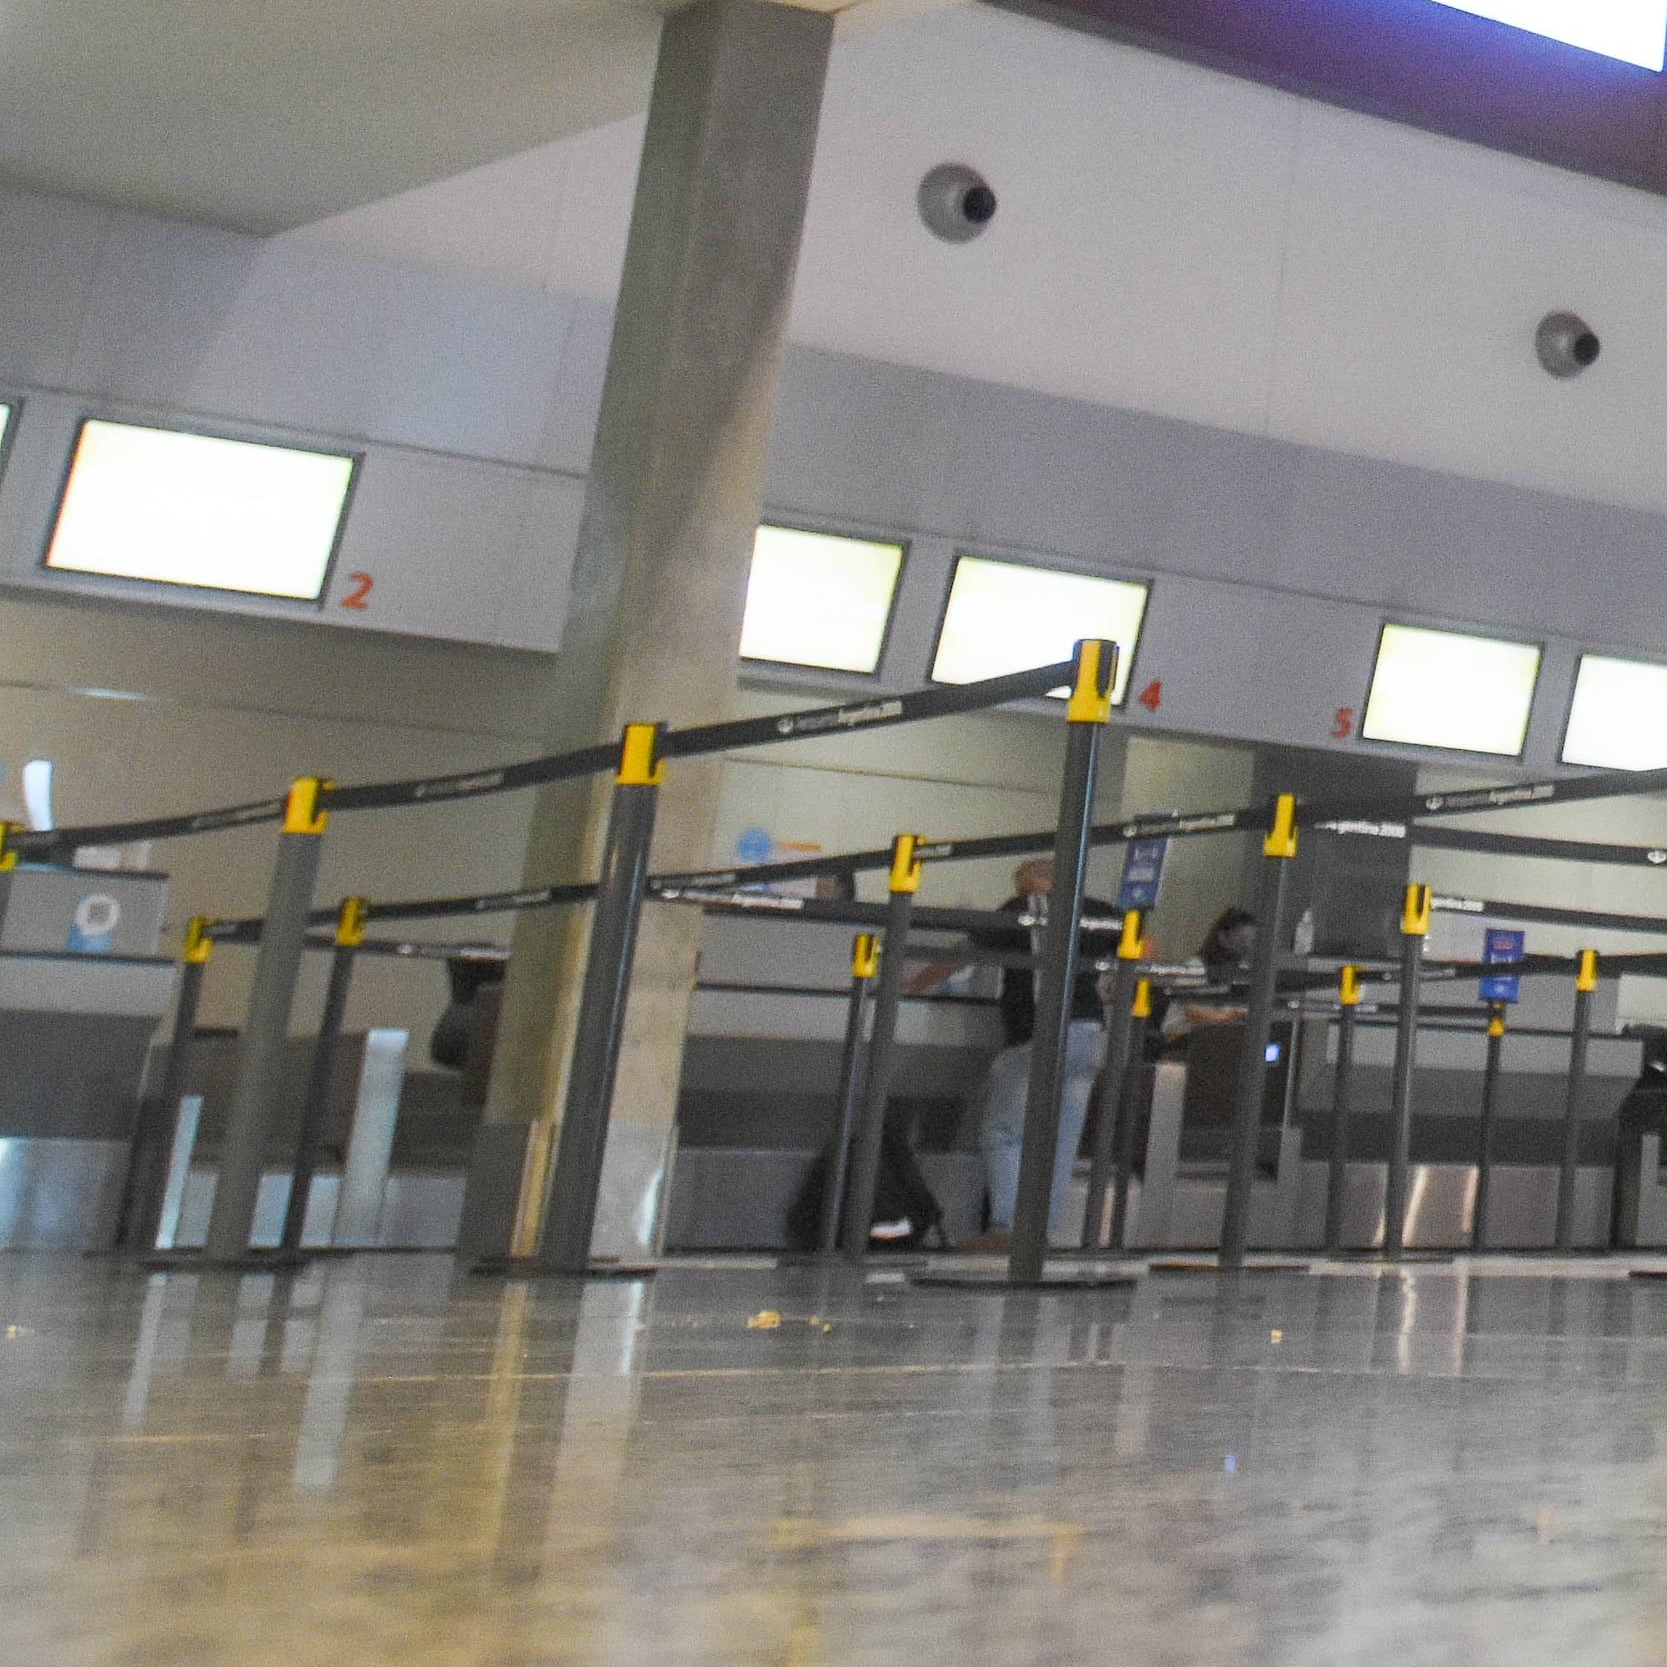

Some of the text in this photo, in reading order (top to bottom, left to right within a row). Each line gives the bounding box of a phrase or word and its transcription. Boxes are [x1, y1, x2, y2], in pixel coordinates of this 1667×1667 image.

[341, 571, 374, 611] 2
[1139, 680, 1162, 711] 4
[1331, 707, 1354, 739] 5
